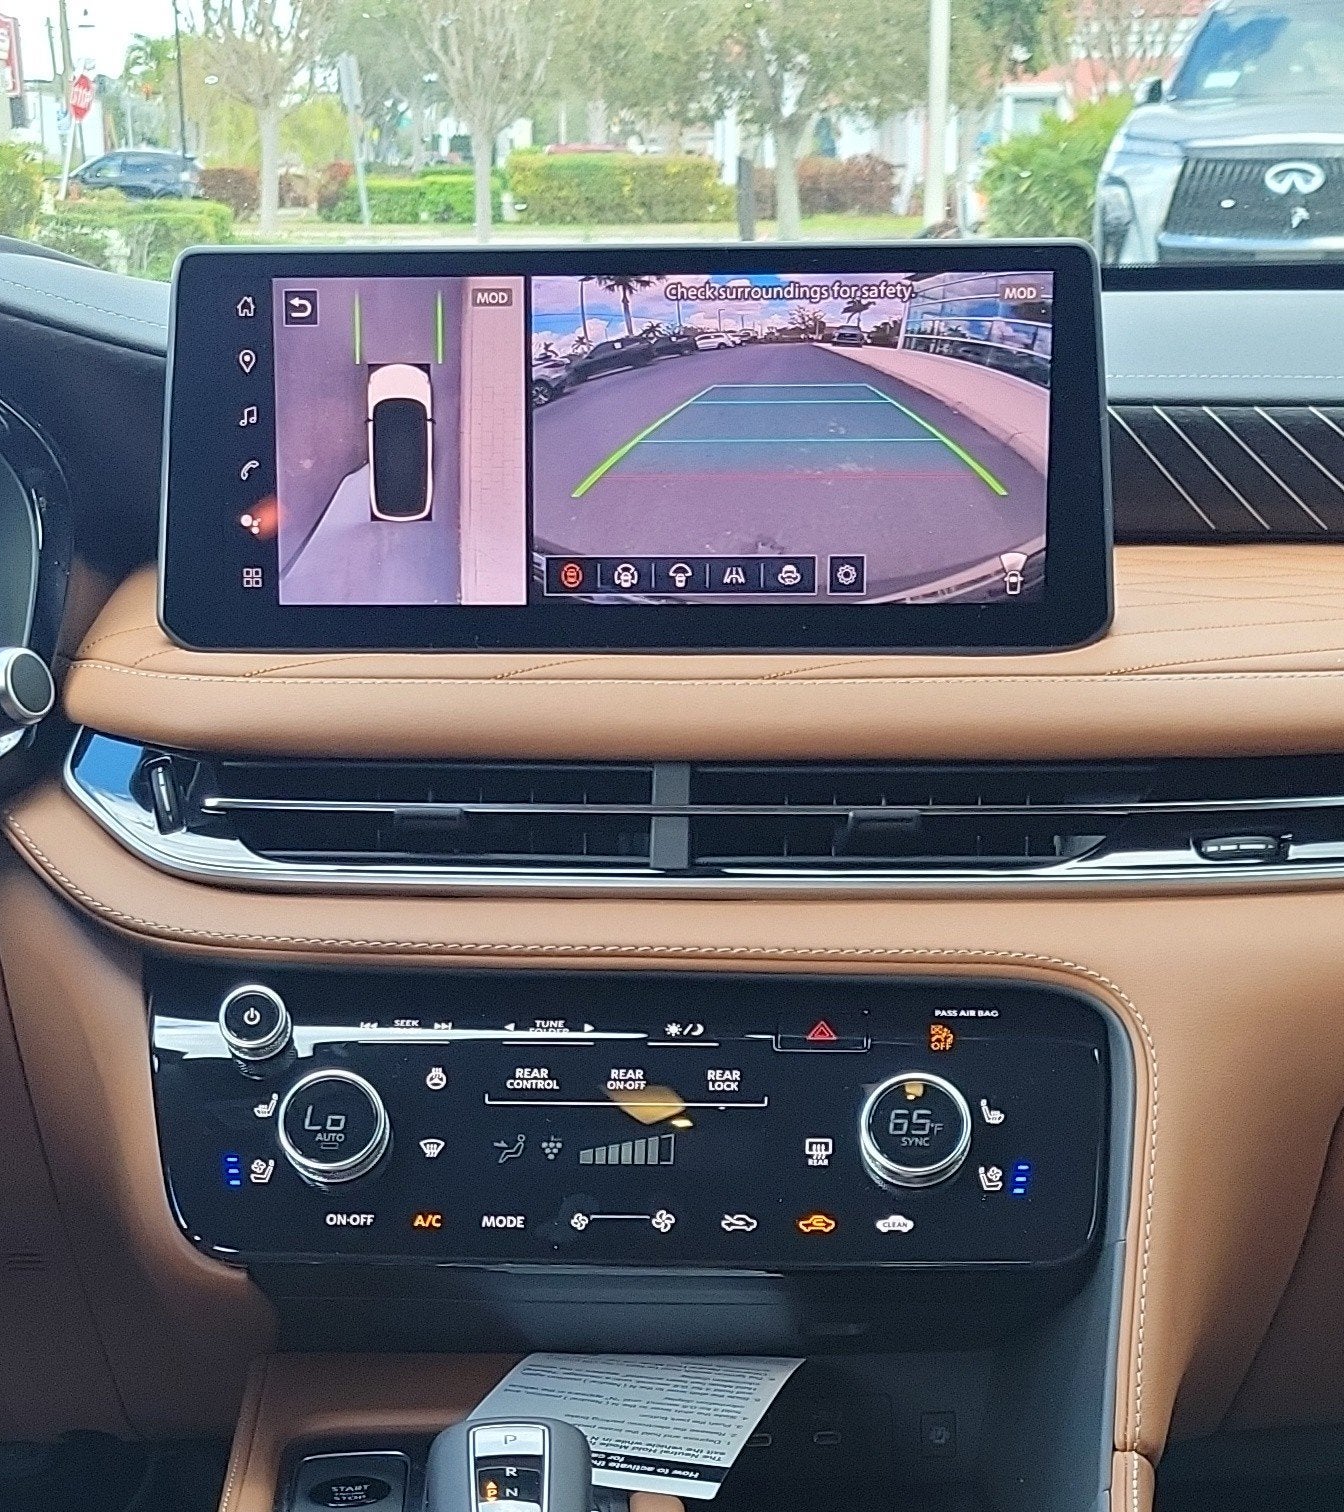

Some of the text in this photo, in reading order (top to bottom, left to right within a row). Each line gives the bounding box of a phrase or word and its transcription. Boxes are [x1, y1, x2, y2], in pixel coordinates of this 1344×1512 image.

[665, 282, 917, 303] Check surroundings for safety.
[1003, 285, 1038, 300] MOD
[477, 291, 509, 305] MOD
[934, 1009, 999, 1017] PASS AIR BAG
[393, 1019, 420, 1028] SEEK
[534, 1019, 566, 1029] TUNE
[930, 1041, 952, 1051] OFF
[515, 1068, 549, 1079] REAR
[610, 1068, 644, 1080] REAR
[707, 1069, 741, 1081] REAR
[506, 1079, 560, 1090] CONTROL
[708, 1081, 739, 1092] LOCK
[315, 1132, 345, 1142] AUTO
[900, 1137, 931, 1147] SYNC
[807, 1158, 829, 1166] REAR
[413, 1214, 442, 1228] A/C
[481, 1215, 525, 1228] MODE
[882, 1221, 908, 1229] CLEAN
[504, 1434, 517, 1445] P
[505, 1466, 518, 1477] R
[608, 1462, 655, 1472] activate
[671, 1469, 700, 1478] How
[331, 1484, 370, 1492] START
[487, 1489, 498, 1497] P
[505, 1488, 518, 1497] N
